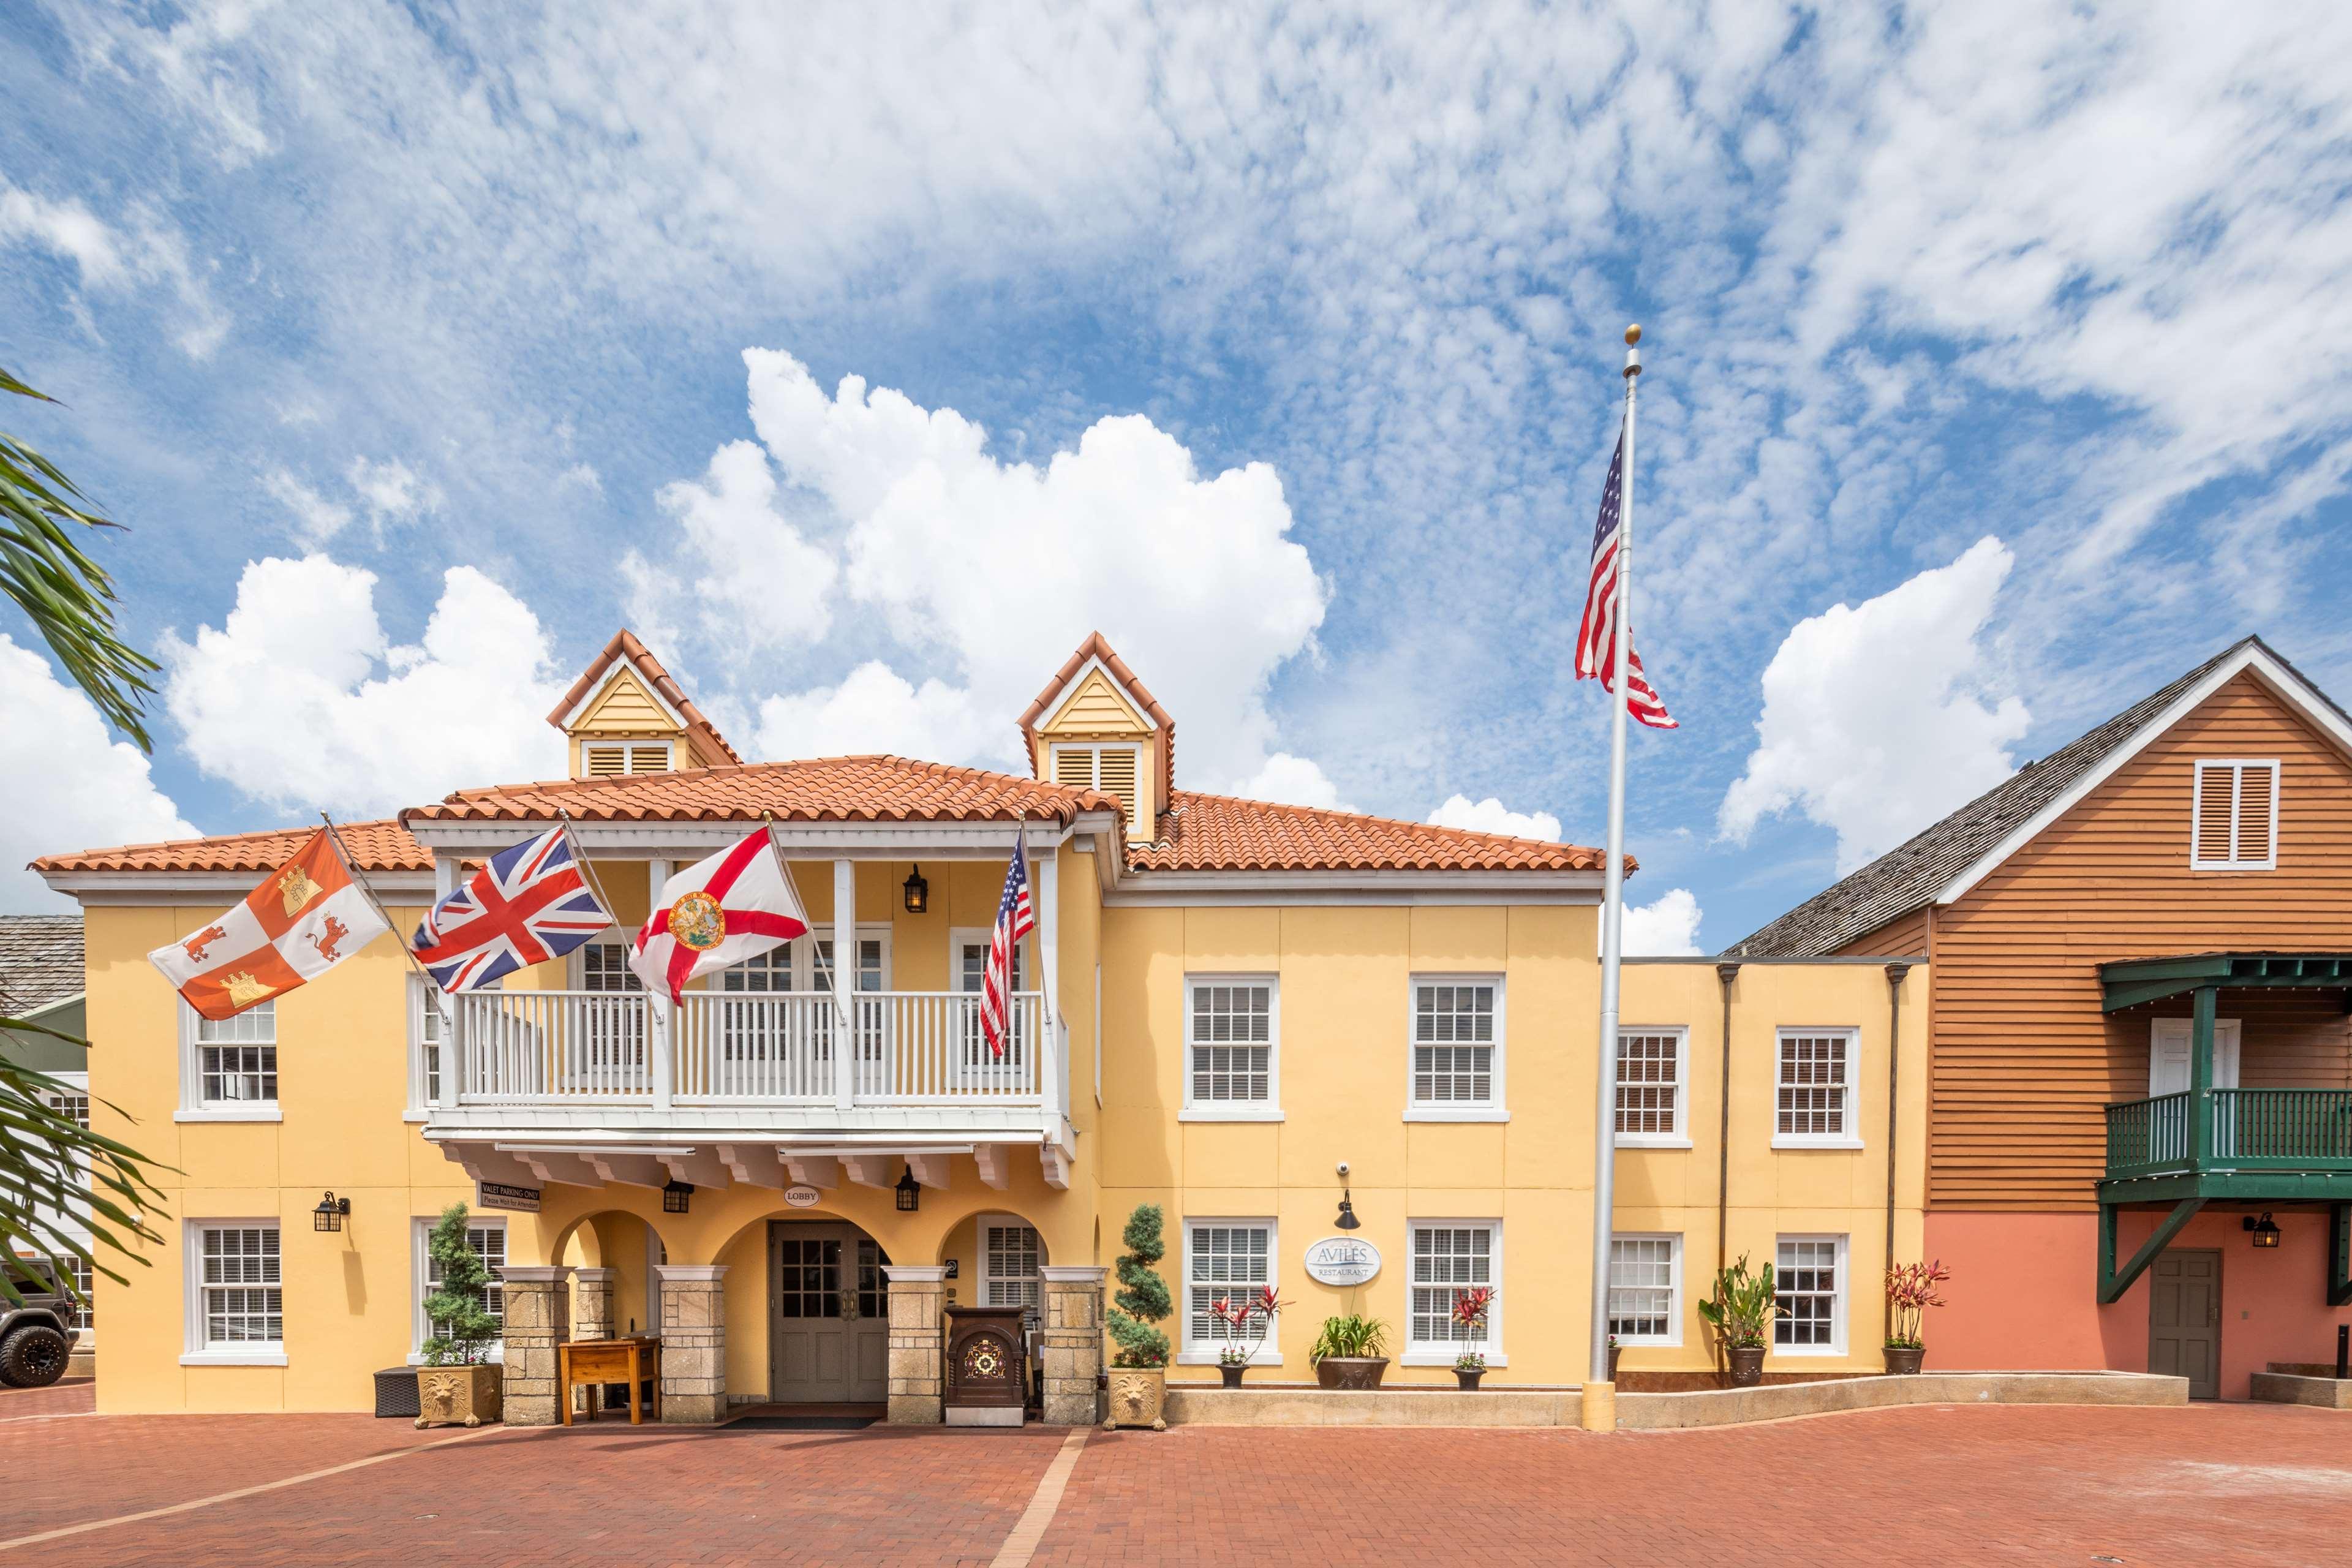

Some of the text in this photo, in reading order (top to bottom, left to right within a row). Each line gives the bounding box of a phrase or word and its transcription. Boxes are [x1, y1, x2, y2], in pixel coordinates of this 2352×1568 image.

[482, 1184, 538, 1199] VALET PARKING ONLY
[484, 1196, 499, 1204] Please
[1317, 1246, 1367, 1262] AVILÉS
